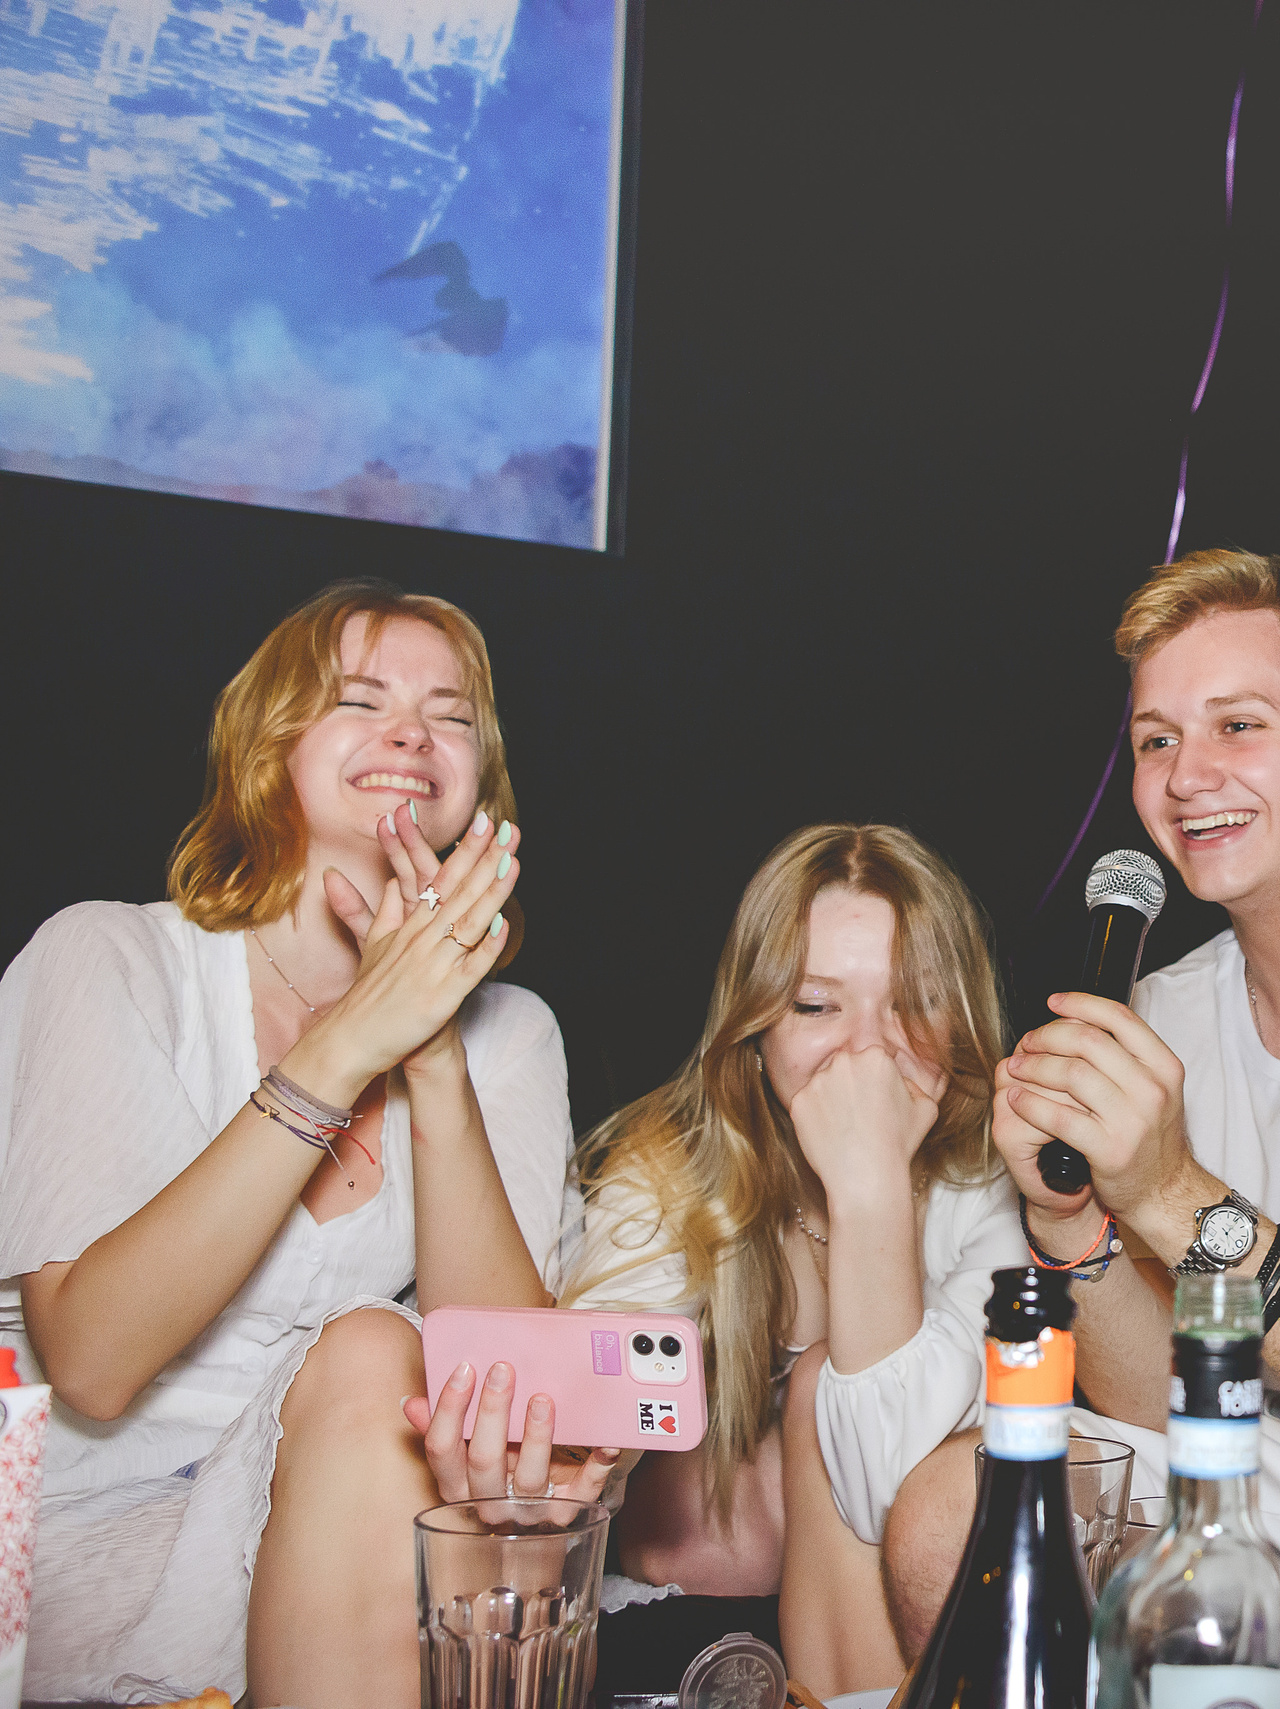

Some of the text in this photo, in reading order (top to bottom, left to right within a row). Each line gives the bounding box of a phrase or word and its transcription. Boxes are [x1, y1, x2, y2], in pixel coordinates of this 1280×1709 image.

[594, 1333, 604, 1373] balance
[639, 1402, 655, 1431] ME
[659, 1403, 673, 1412] I
